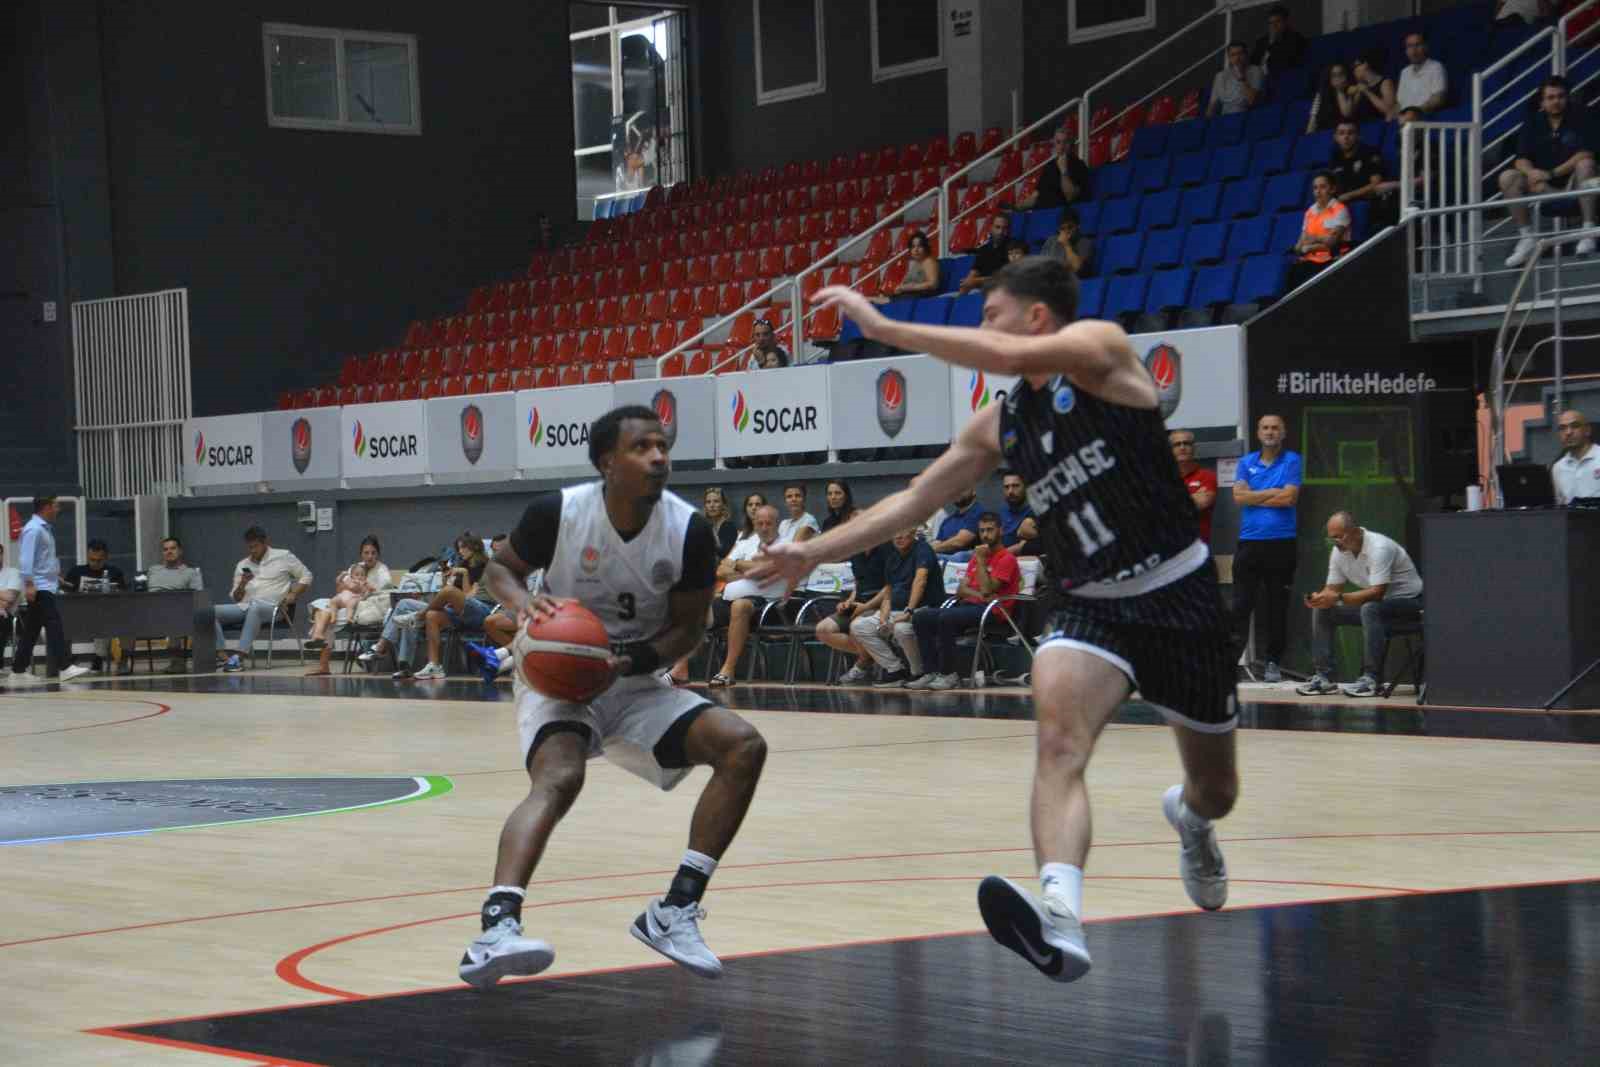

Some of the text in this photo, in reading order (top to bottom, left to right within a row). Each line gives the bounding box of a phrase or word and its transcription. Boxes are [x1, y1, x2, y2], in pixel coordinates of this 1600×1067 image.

[1277, 372, 1437, 395] #BirlikteHedefe
[753, 406, 817, 434] SOCAR
[370, 434, 418, 458] SOCAR
[546, 423, 591, 448] SOCA
[208, 445, 253, 467] SOCAR
[1079, 439, 1116, 477] SC
[1067, 501, 1116, 558] 11
[617, 592, 637, 620] 3
